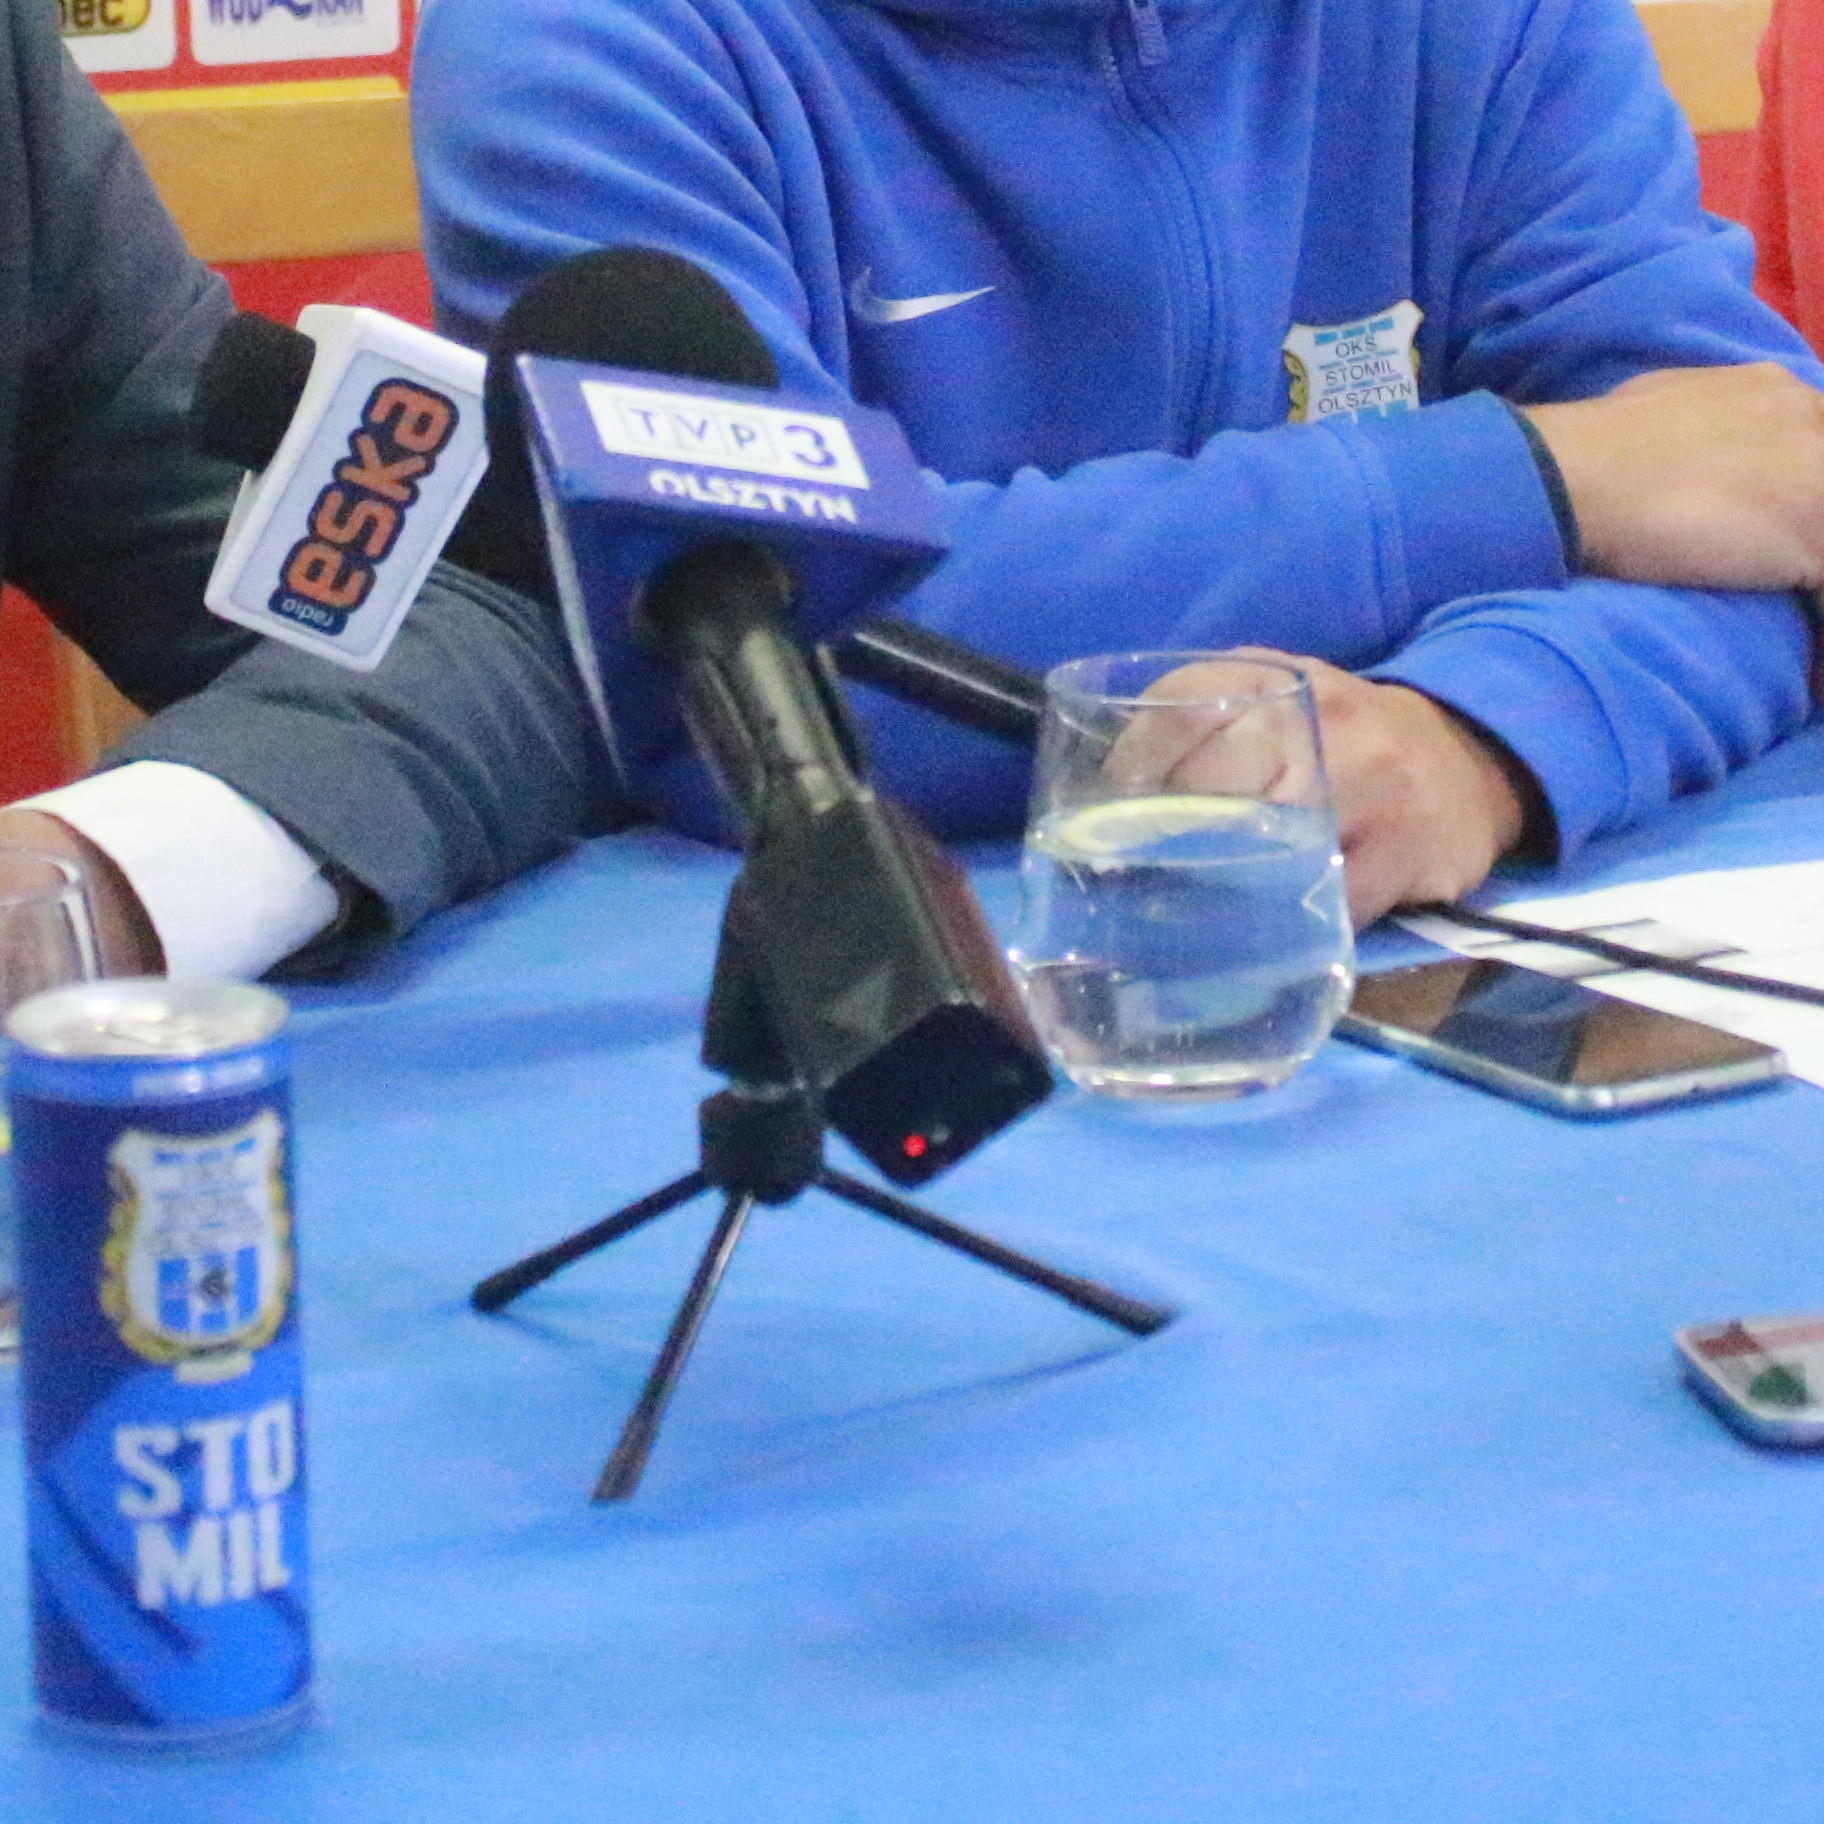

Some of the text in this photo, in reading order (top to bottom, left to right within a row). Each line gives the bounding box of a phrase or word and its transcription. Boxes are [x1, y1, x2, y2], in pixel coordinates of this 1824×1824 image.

[1335, 335, 1376, 359] OKS
[1324, 359, 1398, 388] STOMIL
[1317, 380, 1414, 414] OLSZTYN
[648, 470, 858, 526] OLSZTYN
[278, 592, 336, 632] radio
[114, 1399, 297, 1522] STO
[134, 1501, 292, 1613] MIL
